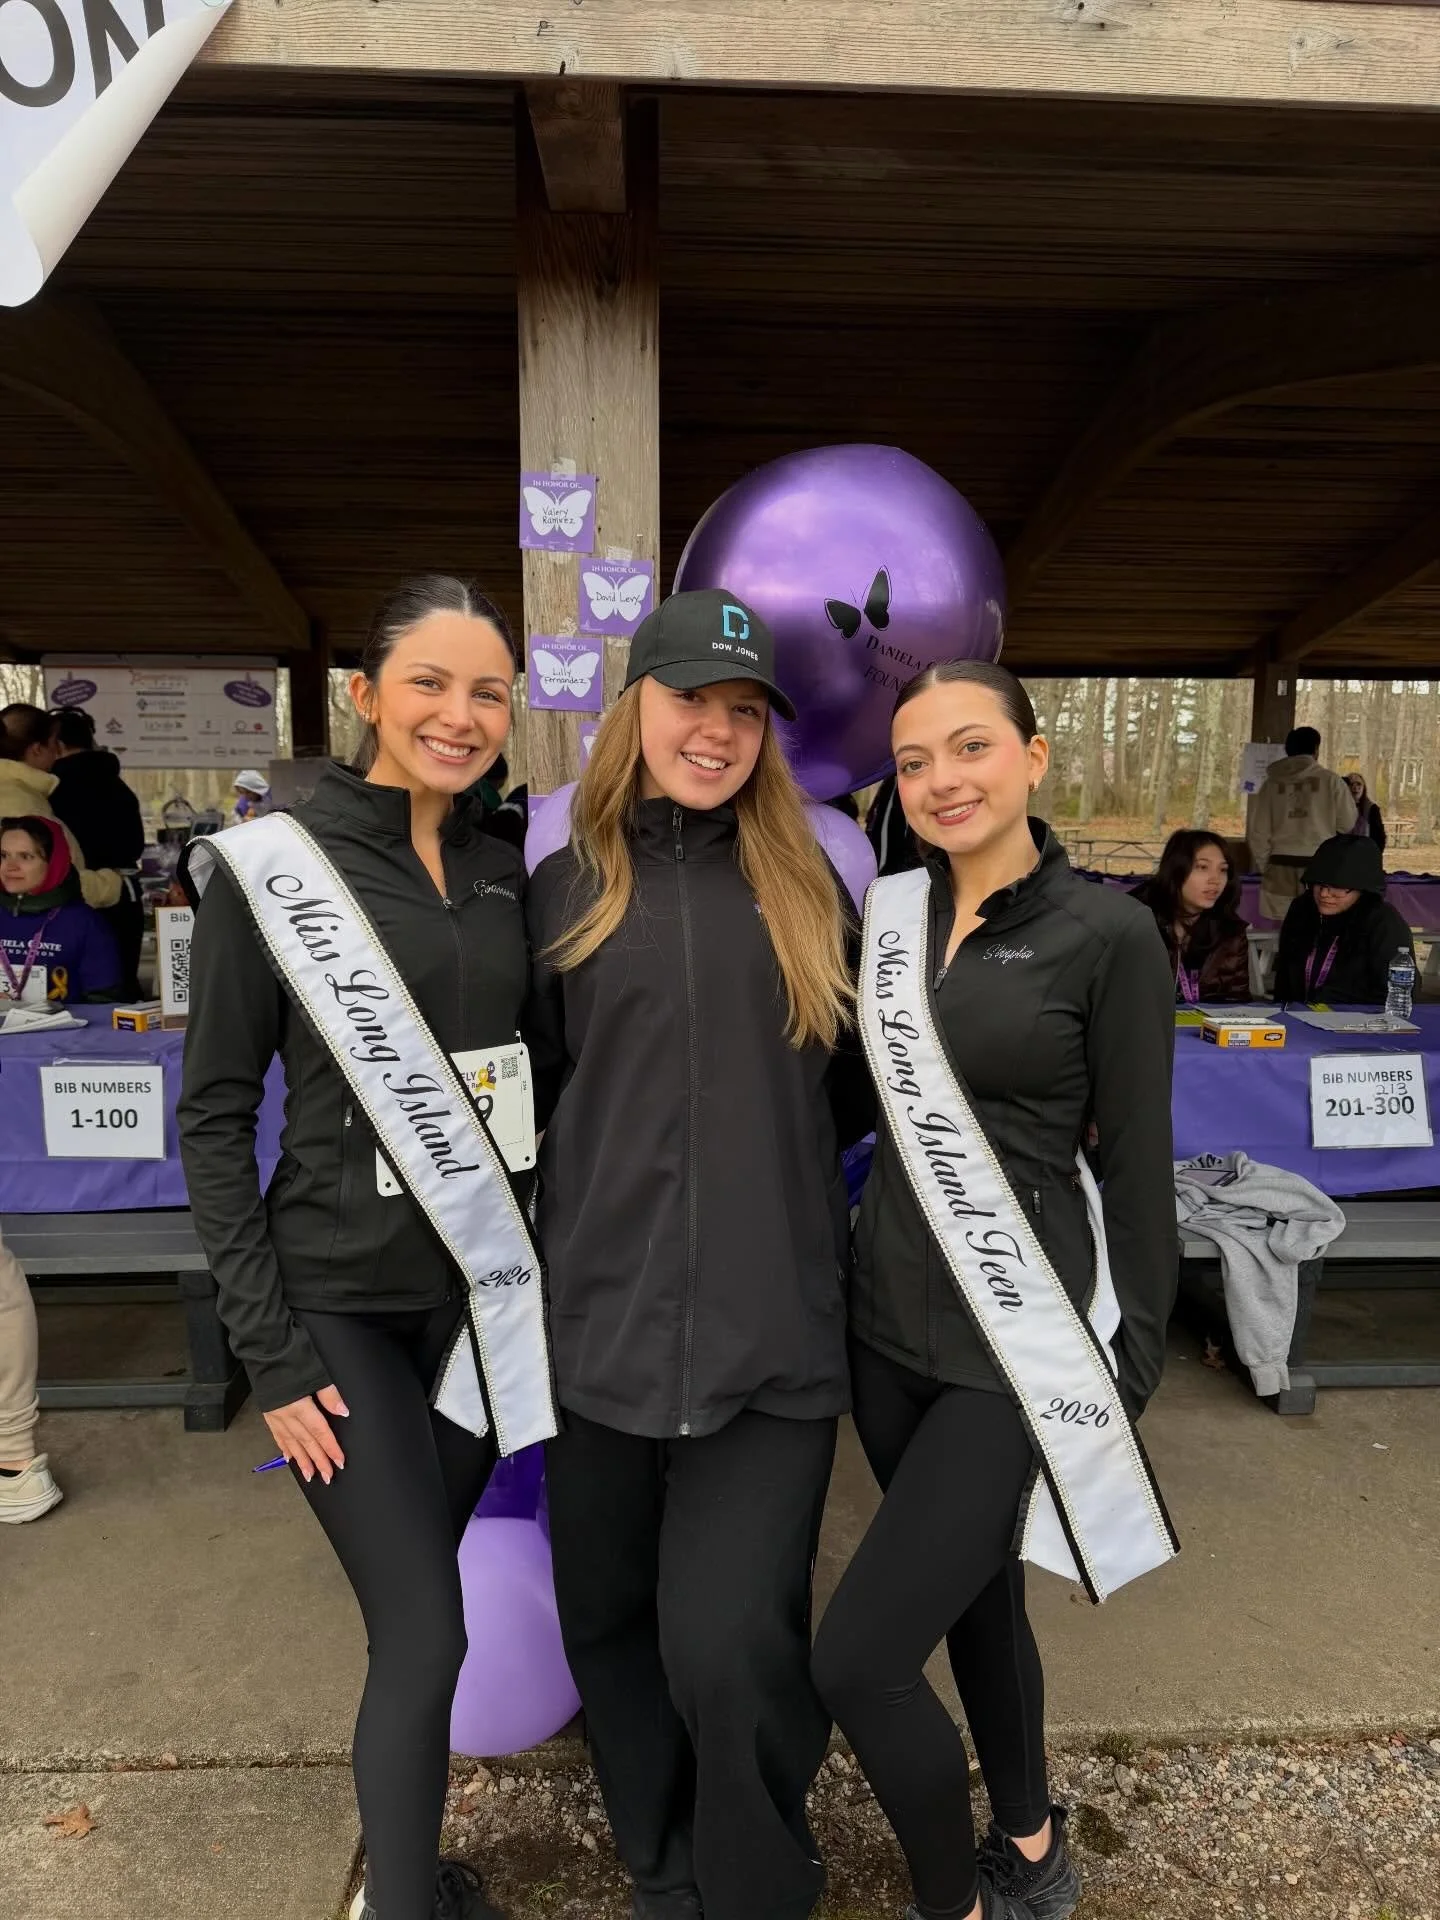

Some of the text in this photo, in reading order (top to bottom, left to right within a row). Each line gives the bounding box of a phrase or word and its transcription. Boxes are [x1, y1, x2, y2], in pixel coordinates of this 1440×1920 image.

[543, 480, 568, 488] HONOR
[595, 591, 641, 605] David Levy
[712, 642, 759, 661] DOW JONES
[866, 635, 921, 670] DANIELA
[544, 676, 588, 684] Fernandez
[864, 665, 906, 691] FOUN
[170, 913, 190, 922] Bib
[265, 874, 480, 1180] Miss Long Island
[54, 1081, 152, 1094] BIB NUMBERS
[1323, 1070, 1413, 1084] BIB NUMBERS
[1325, 1095, 1415, 1117] 201-300
[71, 1108, 138, 1129] 1-100
[874, 930, 1028, 1313] Miss Long Island Teen
[478, 1267, 533, 1288] 2026
[1040, 1397, 1113, 1429] 2026
